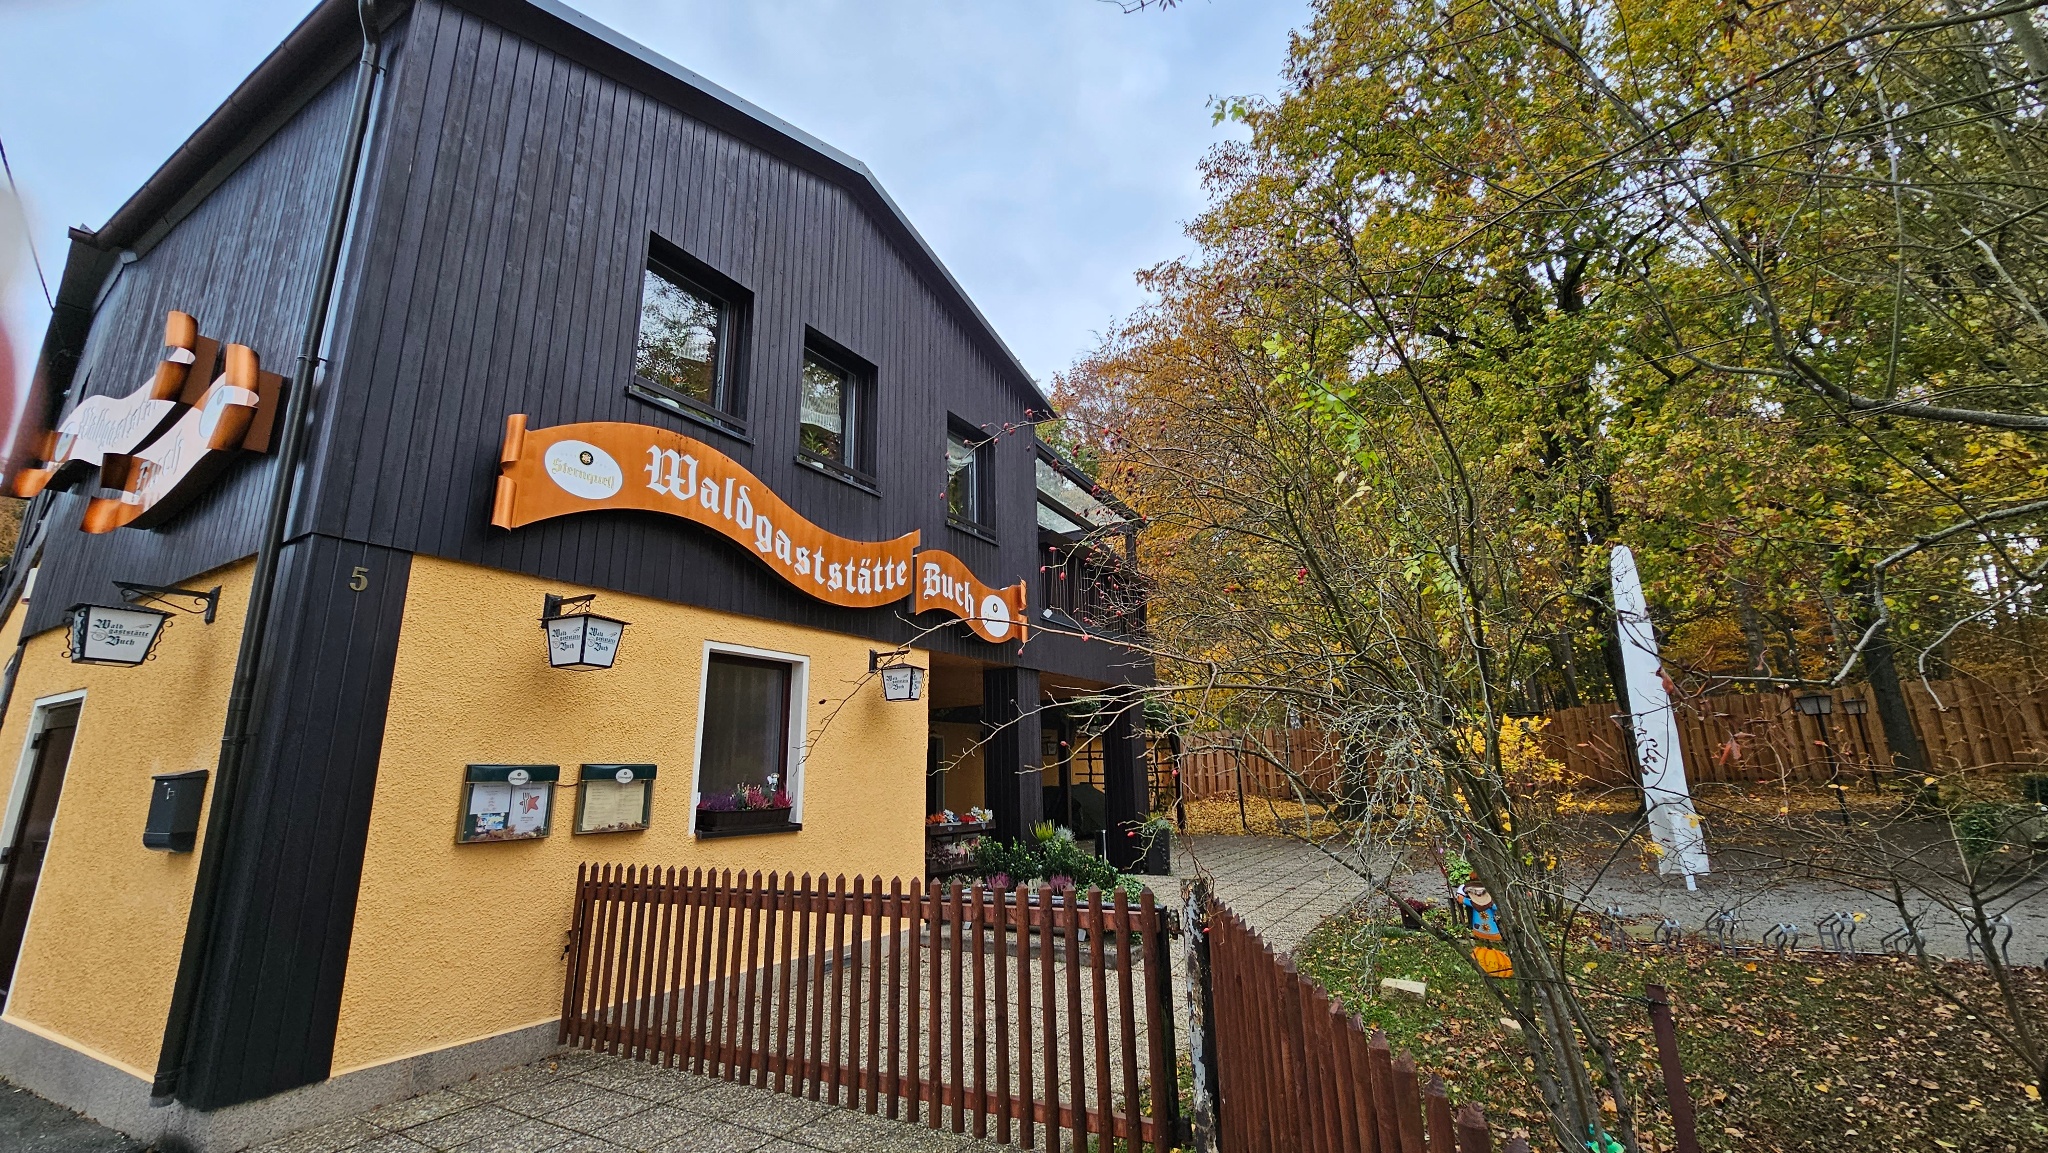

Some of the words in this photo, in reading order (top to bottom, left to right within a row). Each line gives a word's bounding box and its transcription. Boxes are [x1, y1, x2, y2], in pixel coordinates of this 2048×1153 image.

[644, 445, 908, 595] Waldgaststätte
[923, 562, 975, 619] Buch
[350, 566, 370, 591] 5
[93, 618, 124, 630] Wald
[108, 628, 150, 638] gaststätte
[105, 635, 135, 646] Buch
